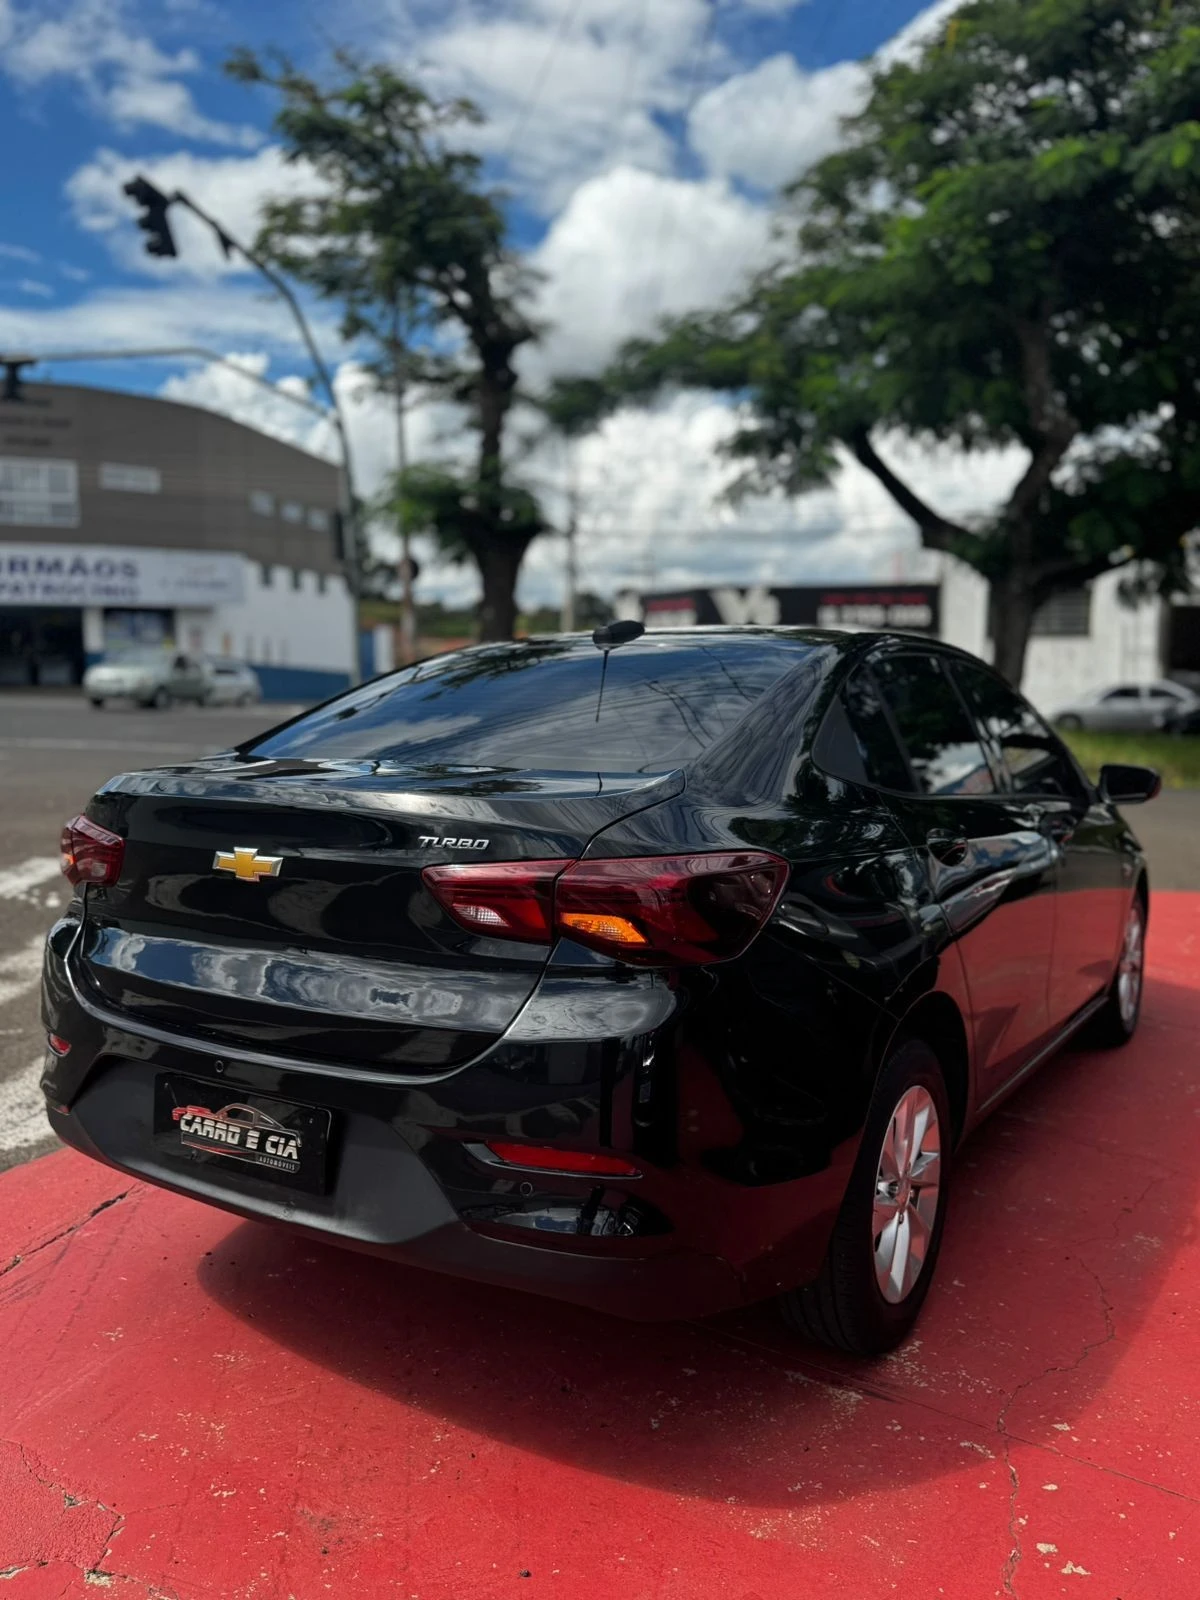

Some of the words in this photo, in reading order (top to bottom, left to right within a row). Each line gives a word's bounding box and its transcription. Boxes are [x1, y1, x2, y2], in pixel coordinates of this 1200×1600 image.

[418, 835, 490, 850] TURBO
[180, 1113, 241, 1146] CARRO
[245, 1130, 260, 1150] E
[265, 1135, 299, 1160] CIA
[259, 1155, 296, 1172] AUTOMÓVEIS
